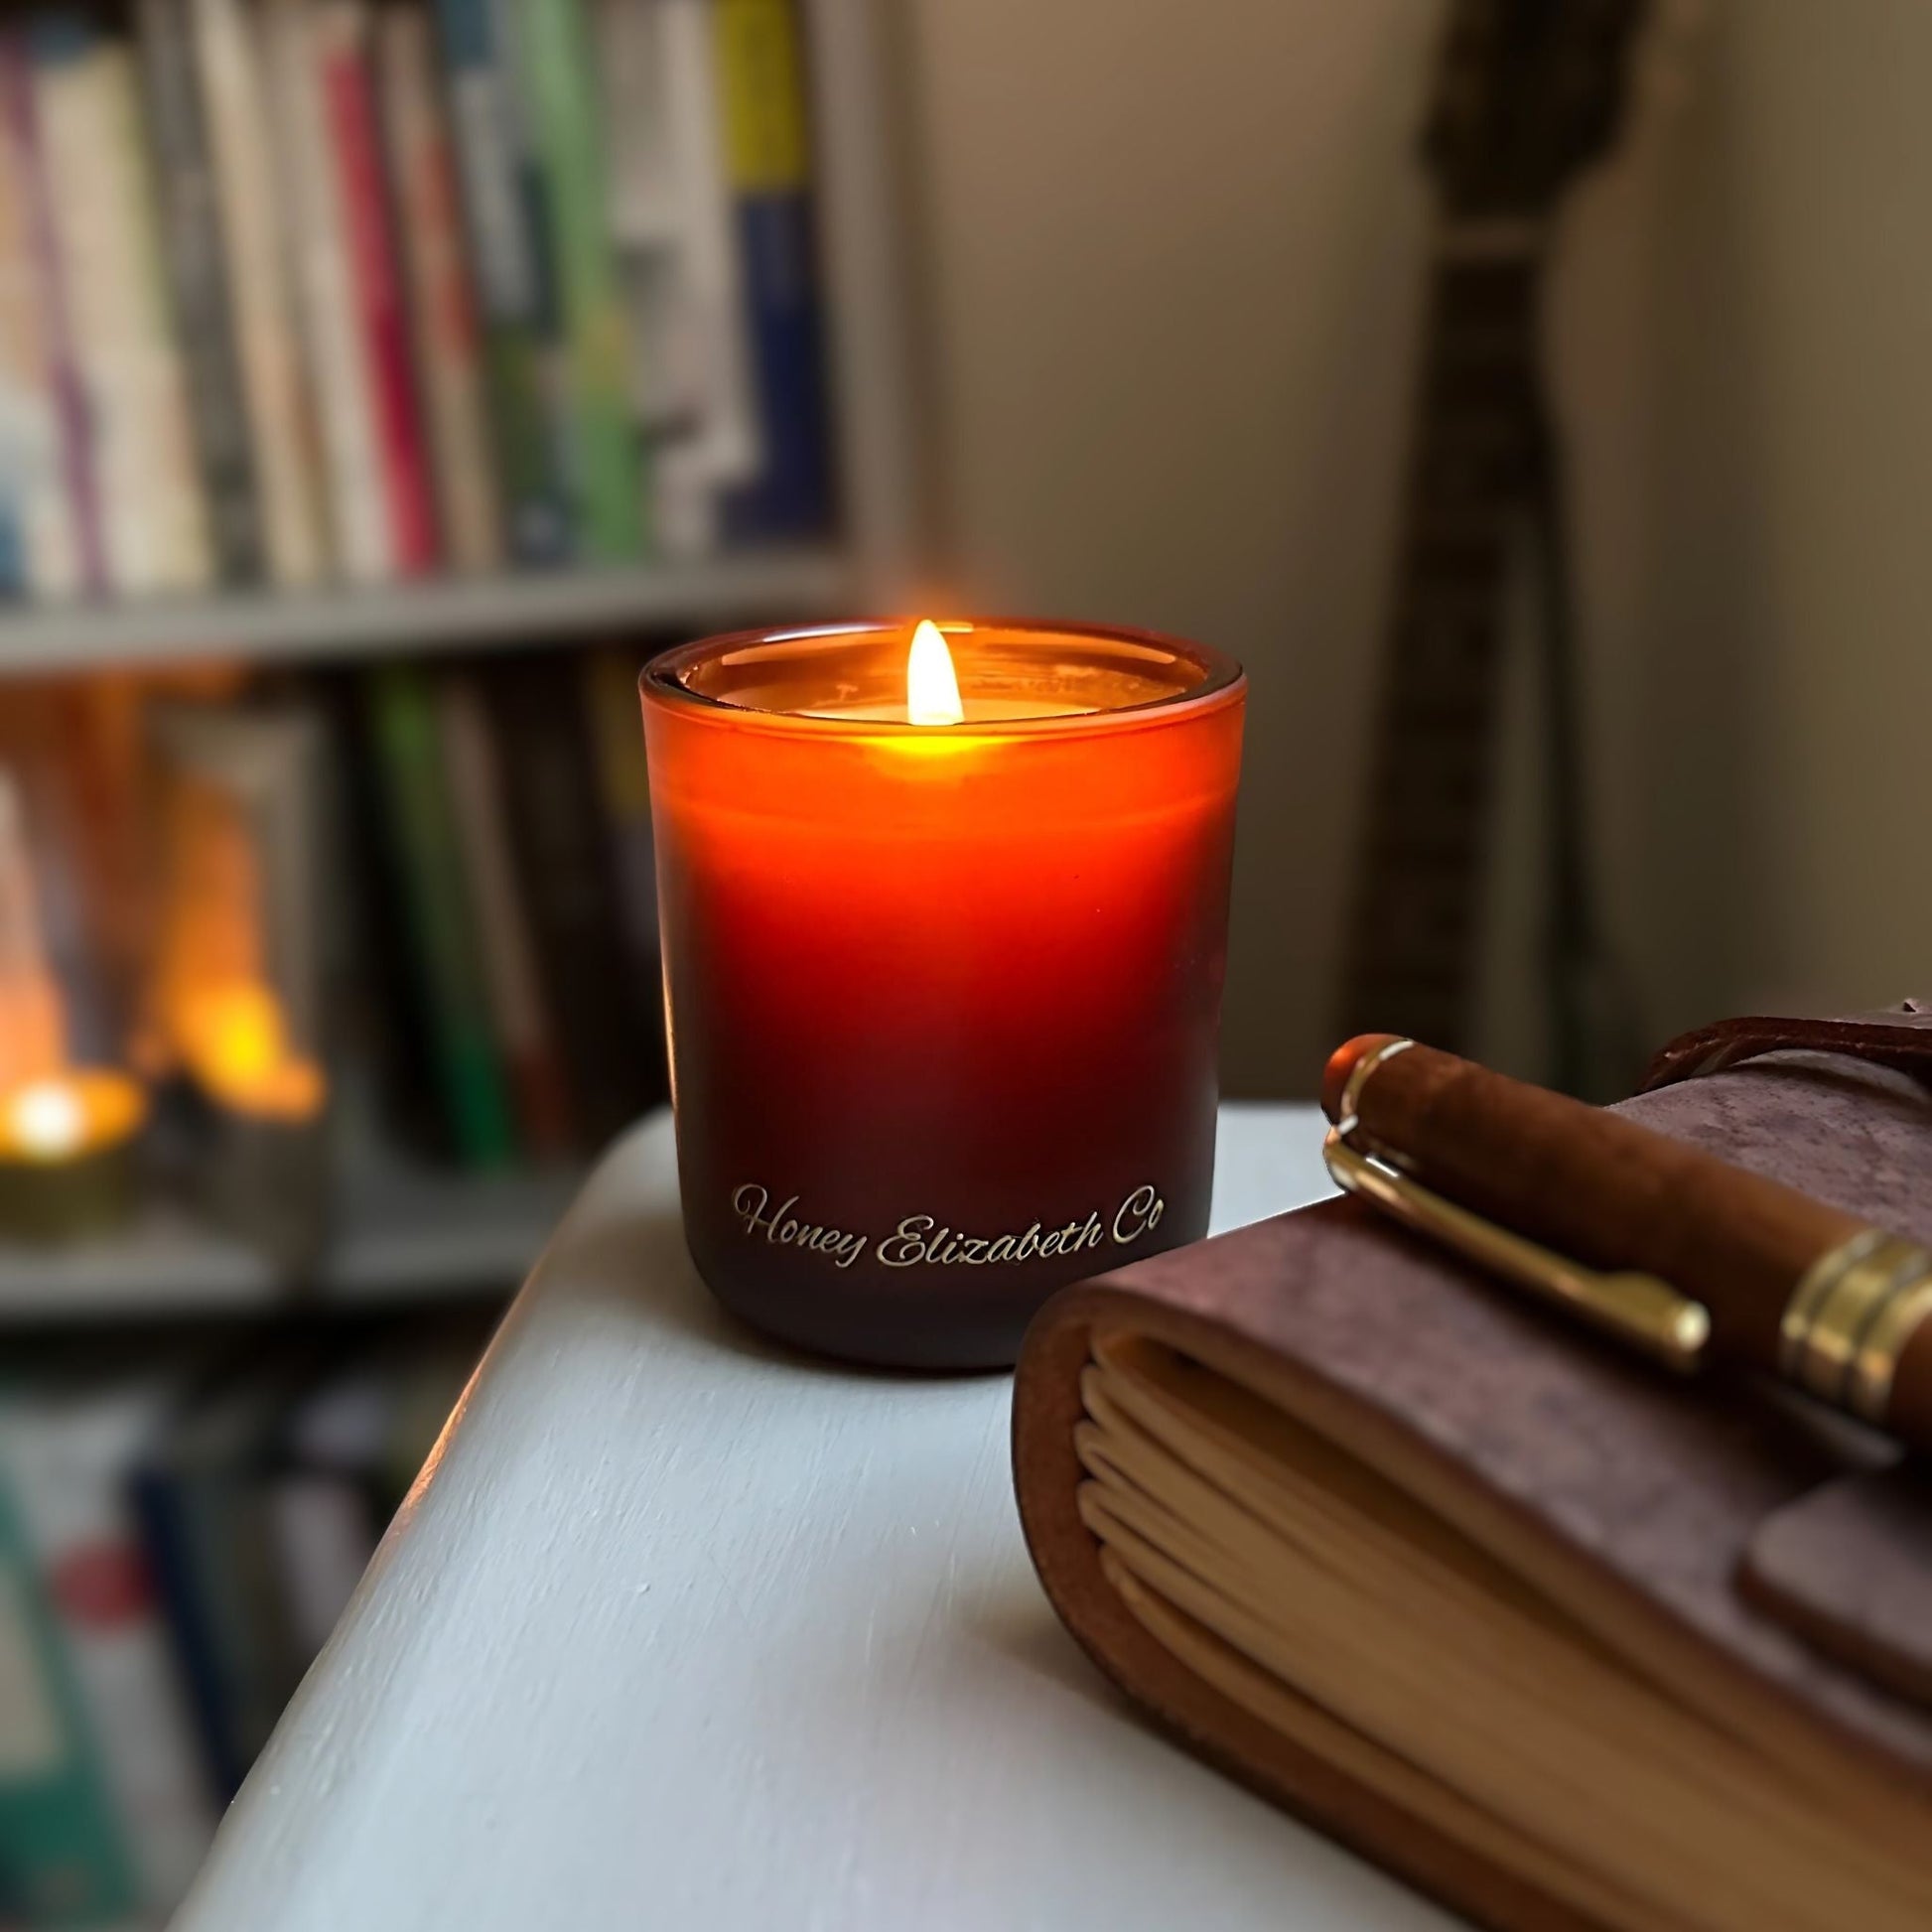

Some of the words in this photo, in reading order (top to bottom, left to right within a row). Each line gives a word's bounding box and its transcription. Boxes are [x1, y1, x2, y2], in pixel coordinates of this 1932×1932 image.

[733, 1183, 868, 1268] Honey
[877, 1211, 1104, 1267] Elizabeth
[1112, 1184, 1165, 1244] Co
